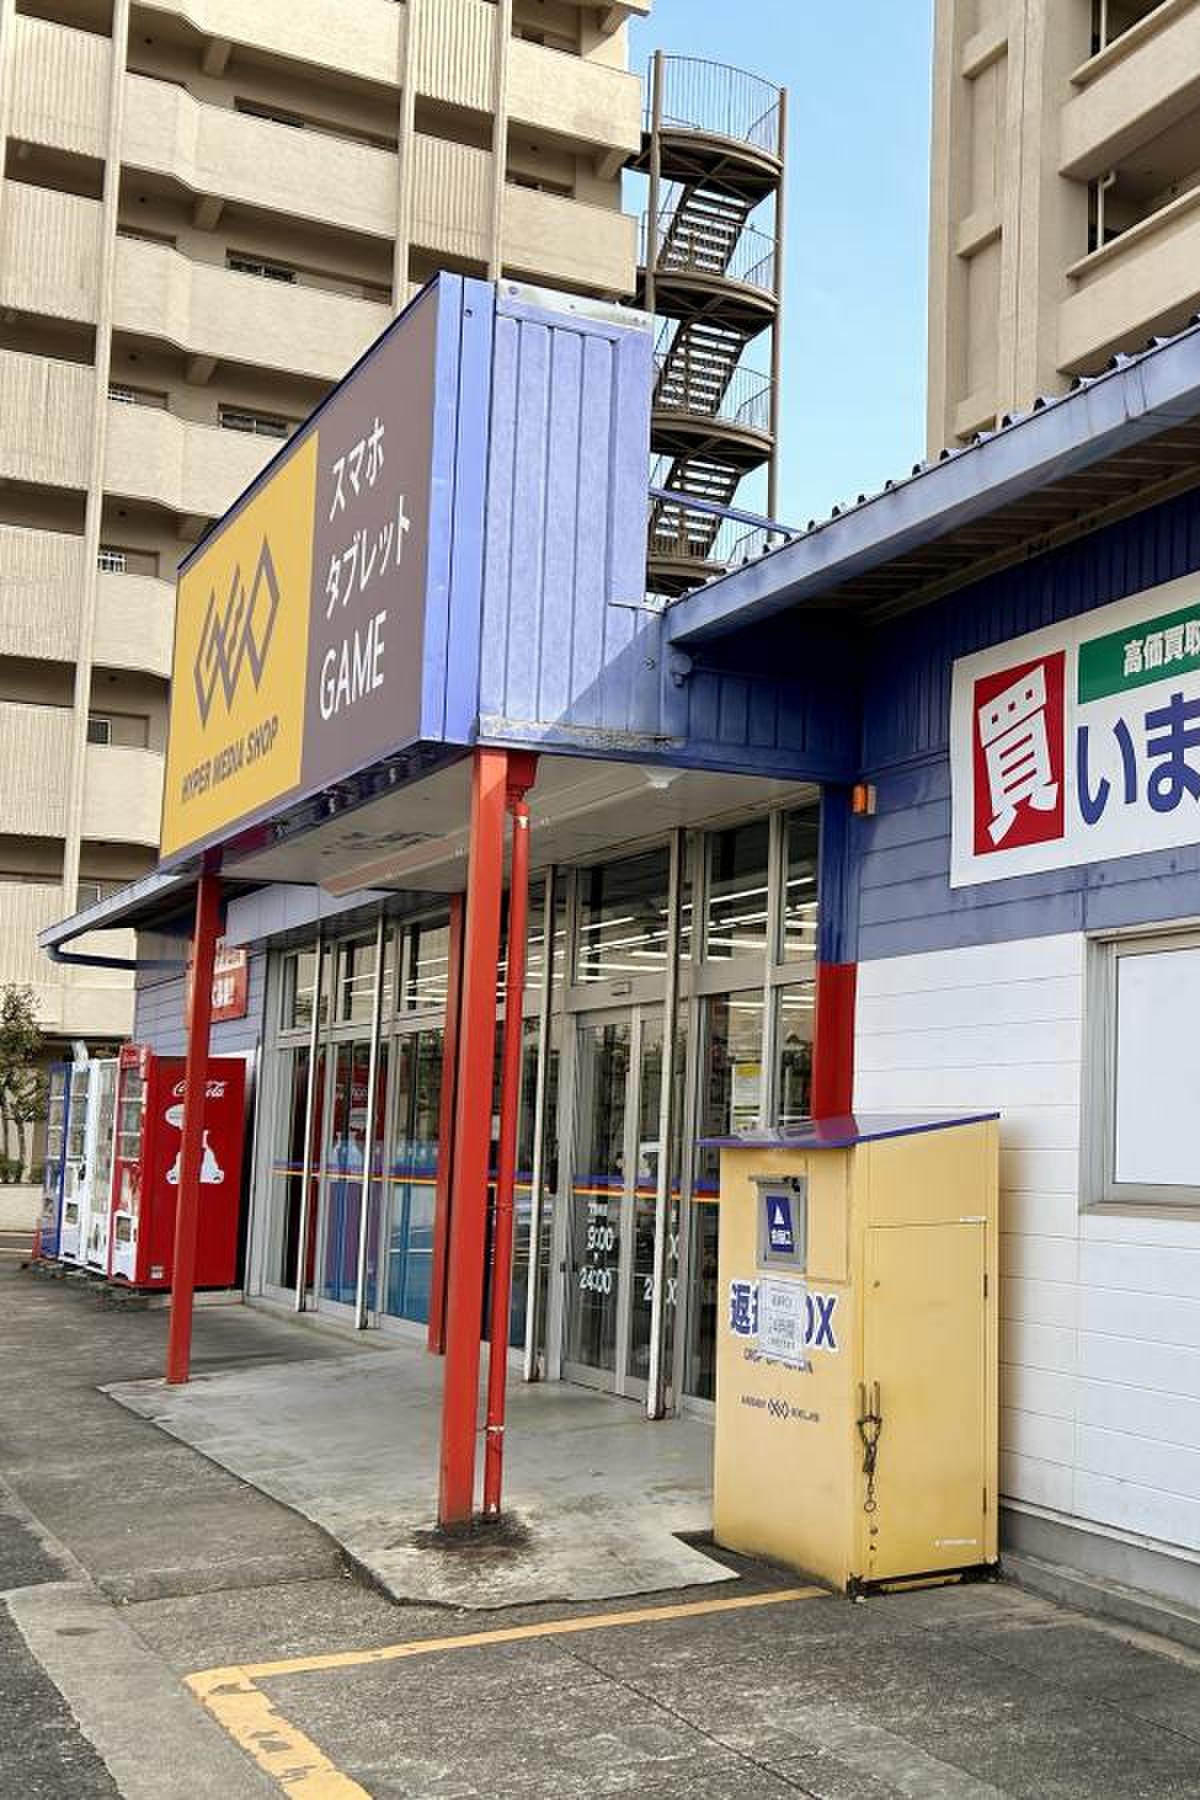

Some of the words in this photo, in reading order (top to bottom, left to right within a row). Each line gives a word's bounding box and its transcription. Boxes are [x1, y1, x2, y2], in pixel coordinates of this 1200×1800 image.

[330, 416, 385, 521] スマホ
[325, 495, 410, 620] タブレット
[319, 609, 387, 721] GAME
[181, 759, 212, 804] HYPER
[212, 737, 247, 787] MEDIA
[246, 714, 280, 766] SHOP
